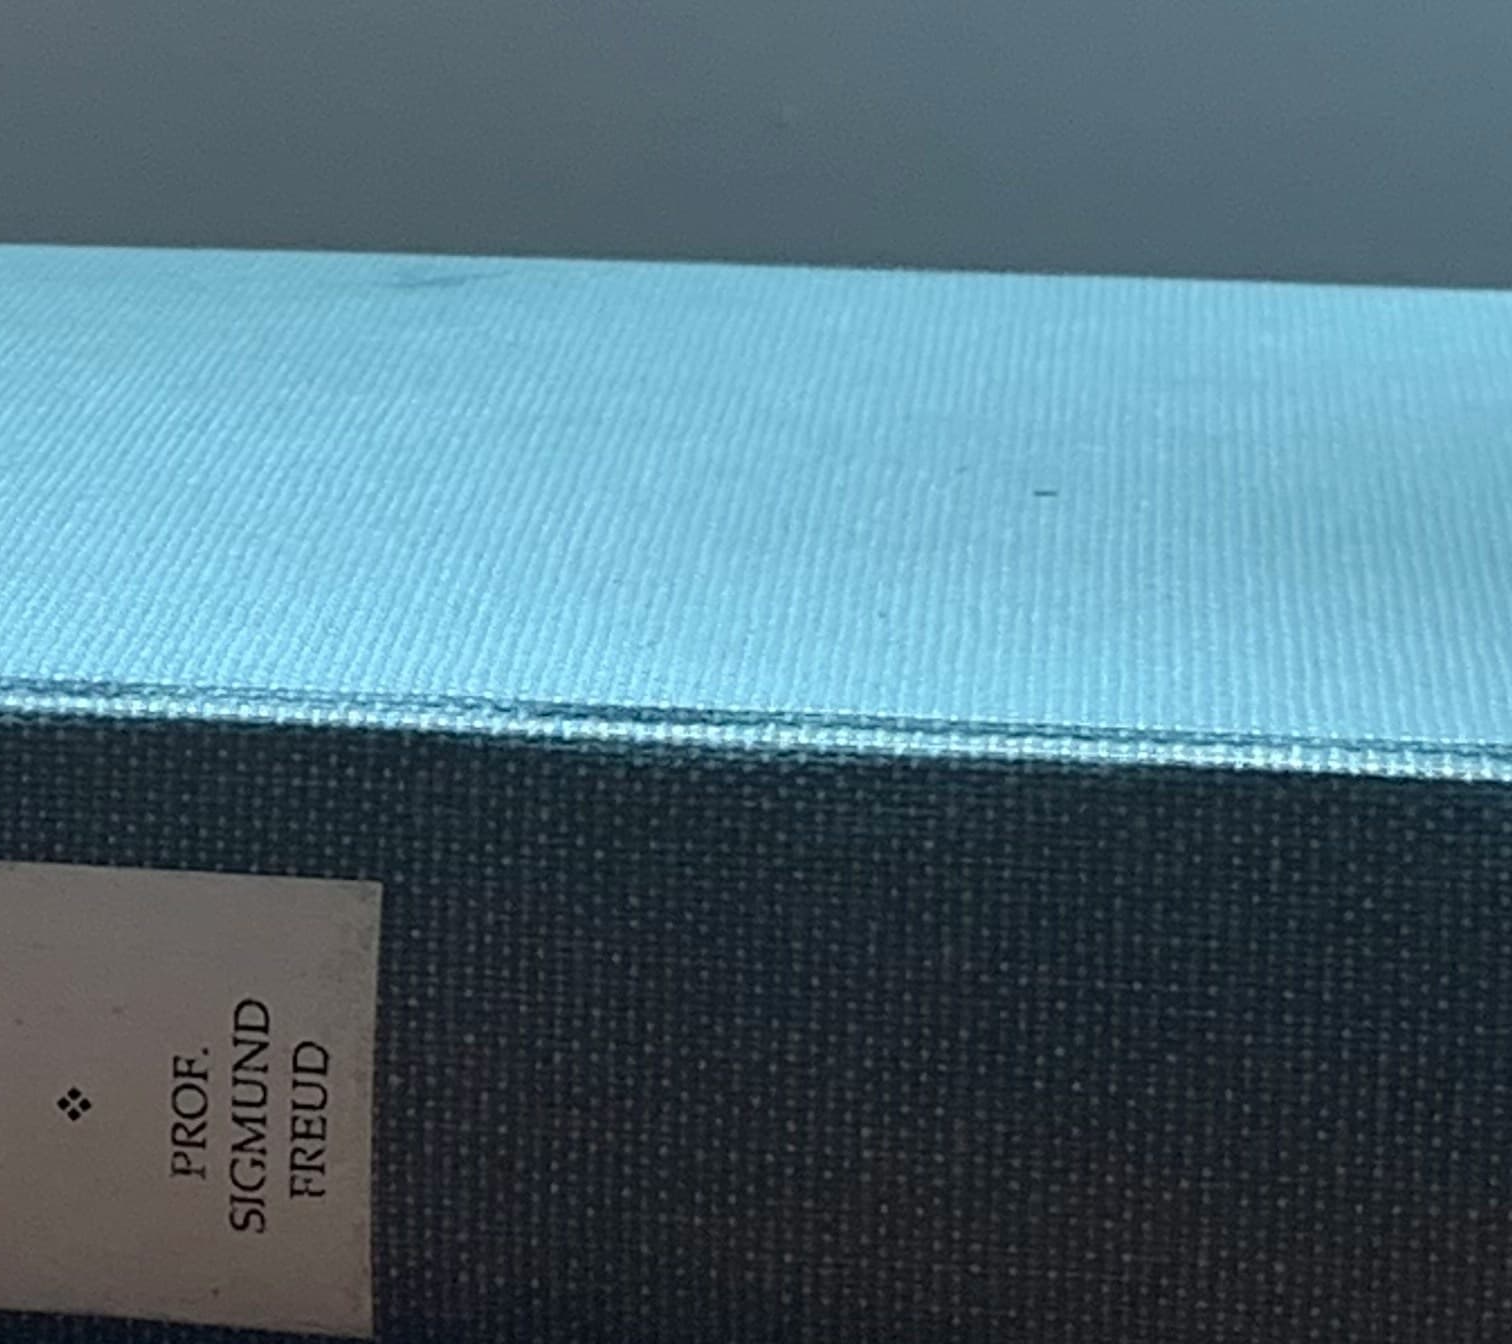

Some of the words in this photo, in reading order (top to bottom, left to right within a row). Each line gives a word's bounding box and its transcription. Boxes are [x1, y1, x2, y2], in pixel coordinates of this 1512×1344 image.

[170, 1047, 209, 1180] PROF.
[228, 998, 270, 1234] SIGMUND
[289, 1041, 330, 1199] FREUD
